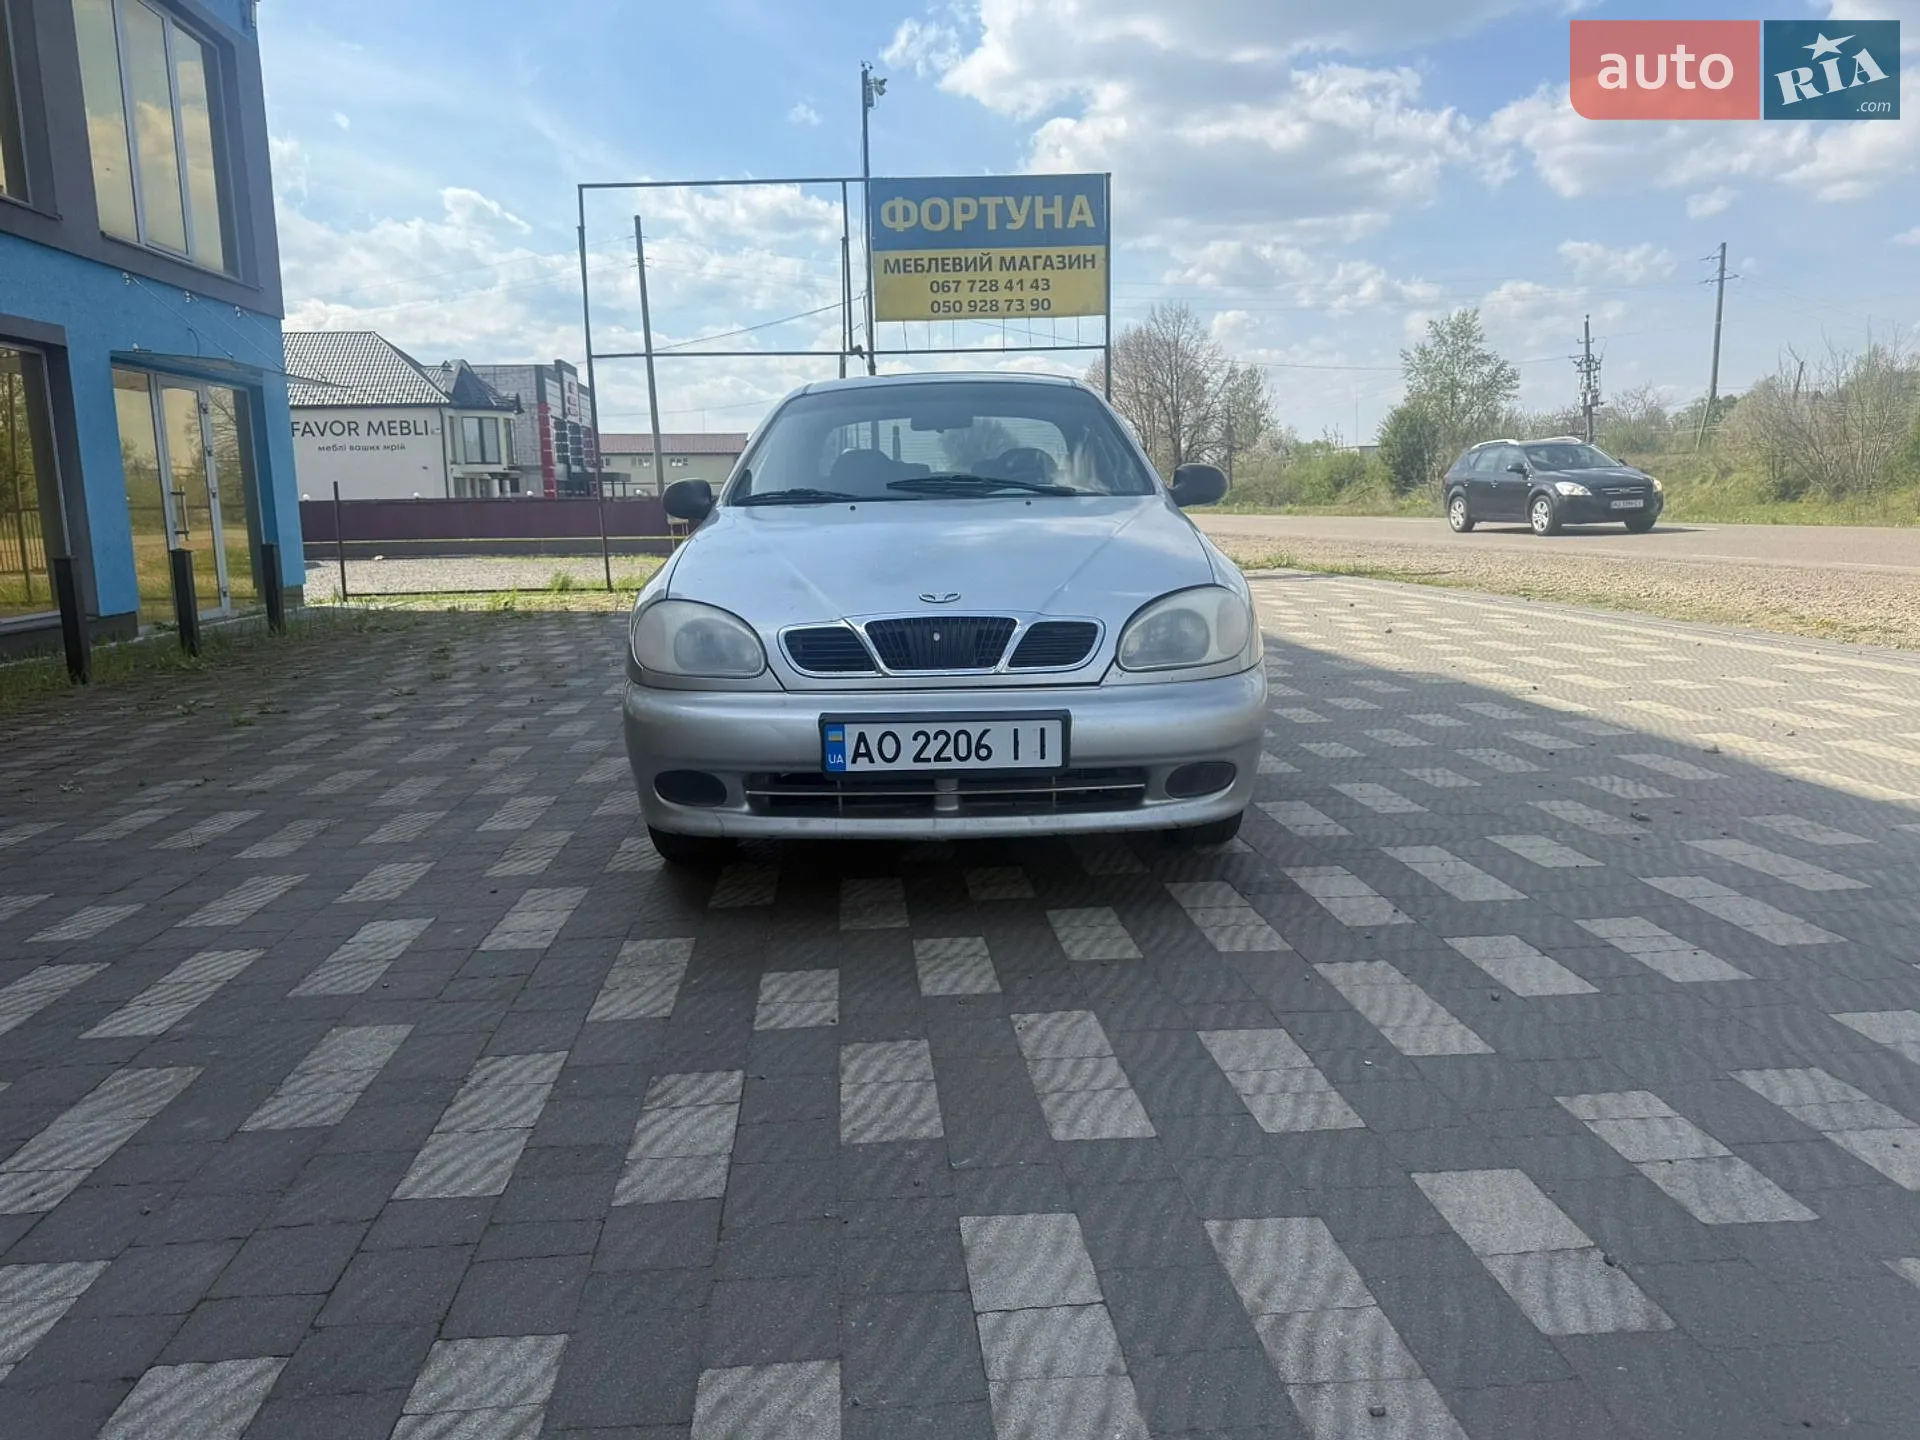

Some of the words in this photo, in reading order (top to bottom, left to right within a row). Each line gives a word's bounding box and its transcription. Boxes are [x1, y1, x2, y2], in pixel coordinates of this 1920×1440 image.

[880, 194, 1096, 232] ФОРТУНА
[883, 252, 993, 274] МЕБЛЕВИЙ
[999, 253, 1096, 272] МАГАЗИН
[929, 280, 962, 294] 067
[967, 279, 1000, 293] 728
[1003, 278, 1025, 292] 41
[1029, 277, 1051, 291] 43
[930, 300, 963, 314] 050
[967, 299, 1000, 313] 928
[1004, 298, 1025, 312] 73
[1030, 297, 1052, 311] 90
[291, 419, 360, 437] FAVOR
[366, 419, 429, 436] MEBLI
[912, 728, 994, 764] 2206
[828, 754, 844, 764] UA
